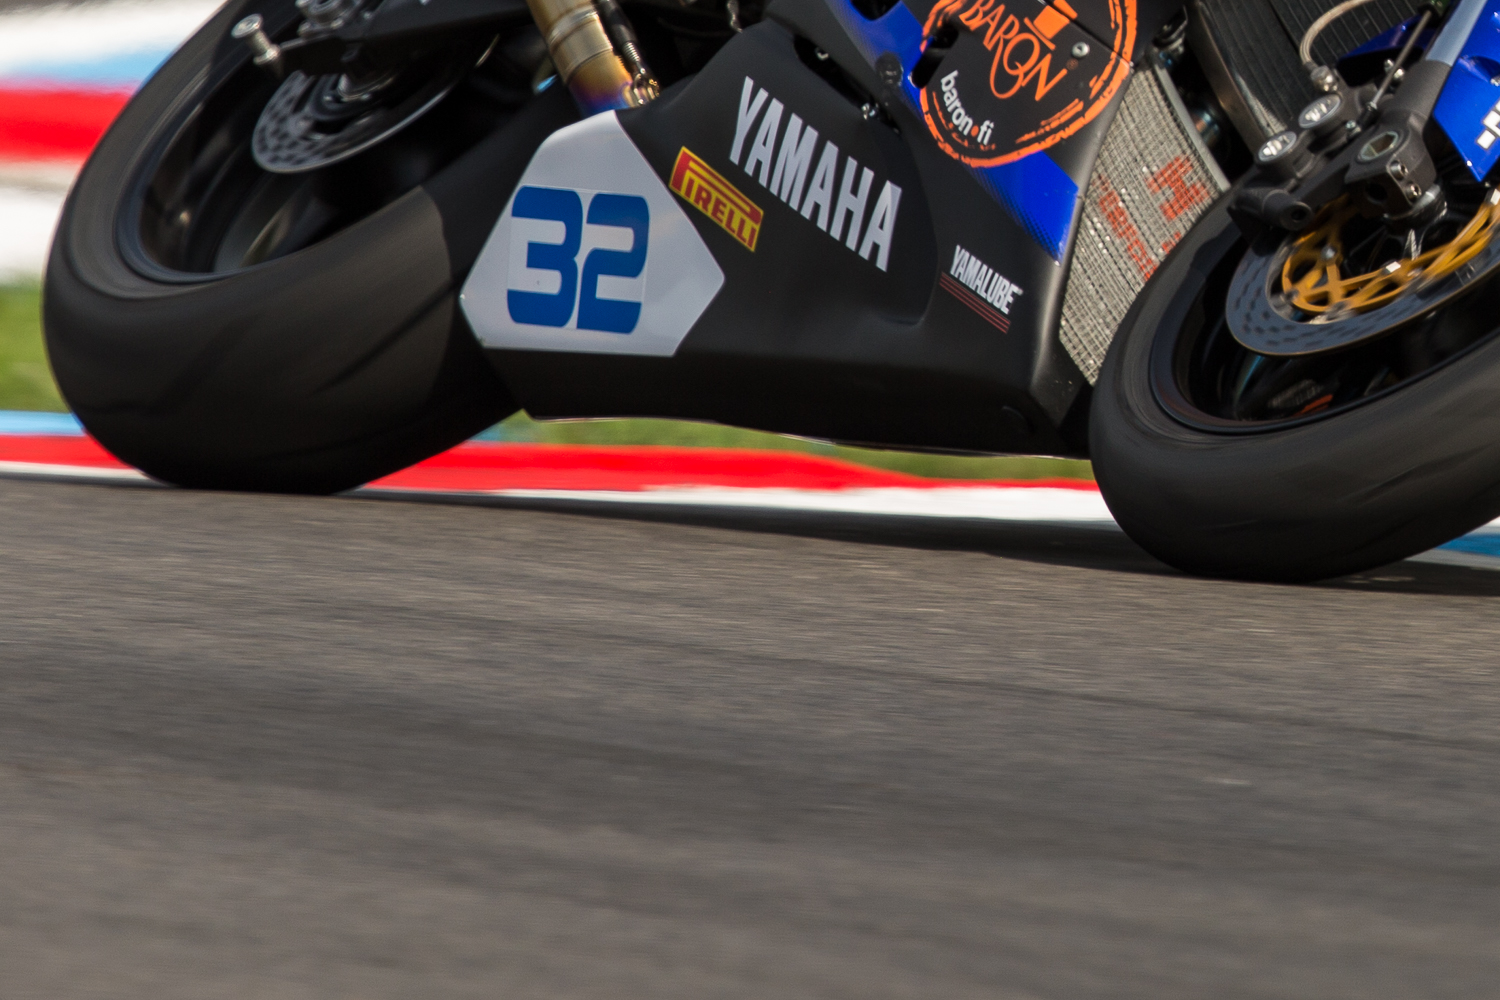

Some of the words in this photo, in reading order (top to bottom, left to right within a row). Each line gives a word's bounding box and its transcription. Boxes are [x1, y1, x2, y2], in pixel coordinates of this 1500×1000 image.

[670, 148, 763, 251] PIRELLI
[729, 75, 902, 274] YAMAHA
[506, 185, 650, 334] 32
[949, 245, 1022, 316] YAMALUBE
